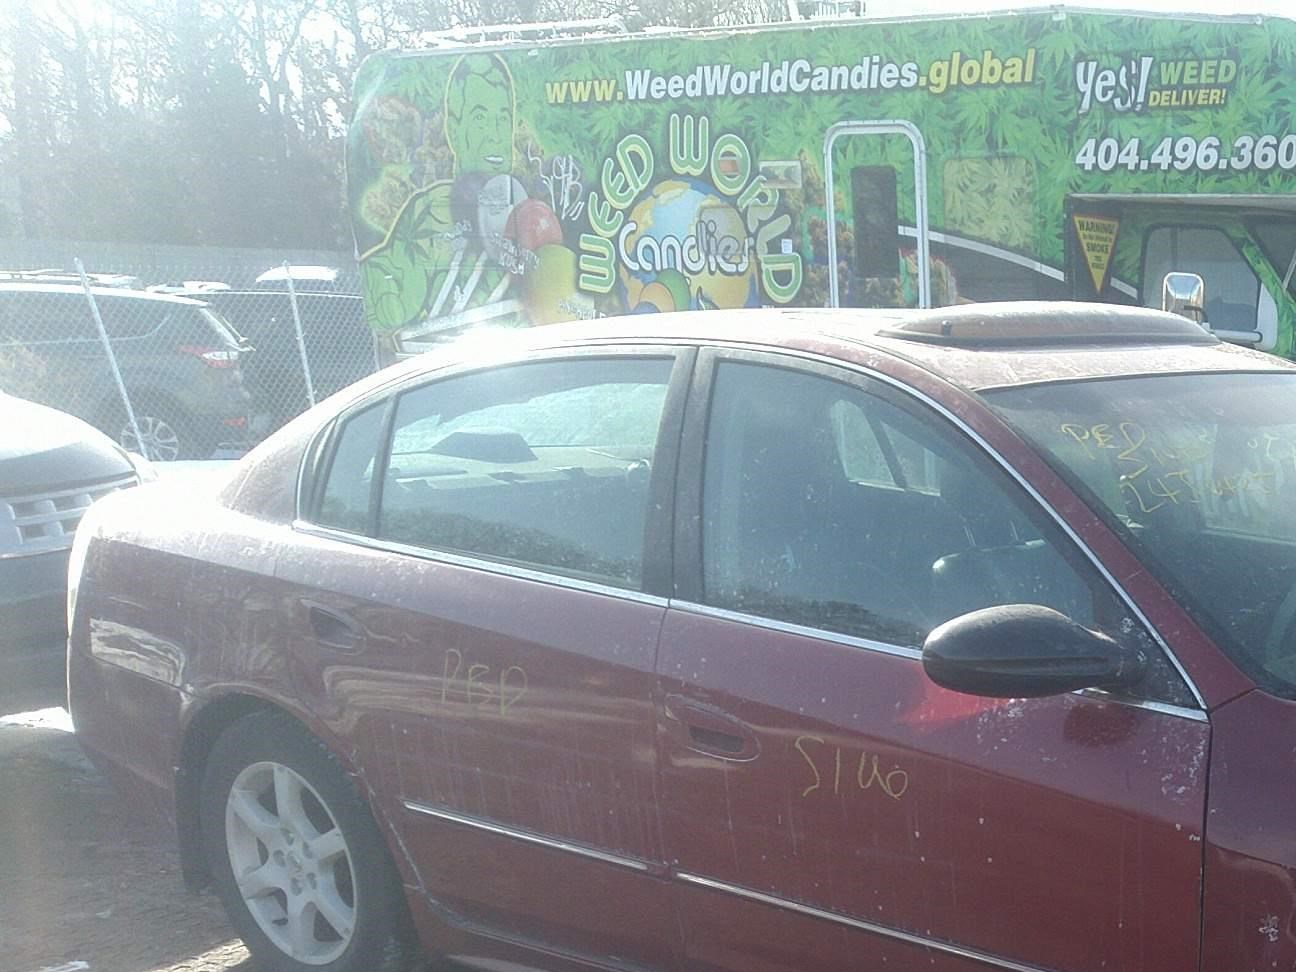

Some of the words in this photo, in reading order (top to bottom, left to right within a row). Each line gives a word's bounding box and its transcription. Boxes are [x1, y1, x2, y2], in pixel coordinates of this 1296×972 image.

[545, 48, 1036, 103] www.WeedWorldCandies.global
[1147, 88, 1227, 108] DELIVER!
[1160, 59, 1237, 86] WEED
[579, 133, 654, 294] WEED
[619, 219, 755, 274] Candies
